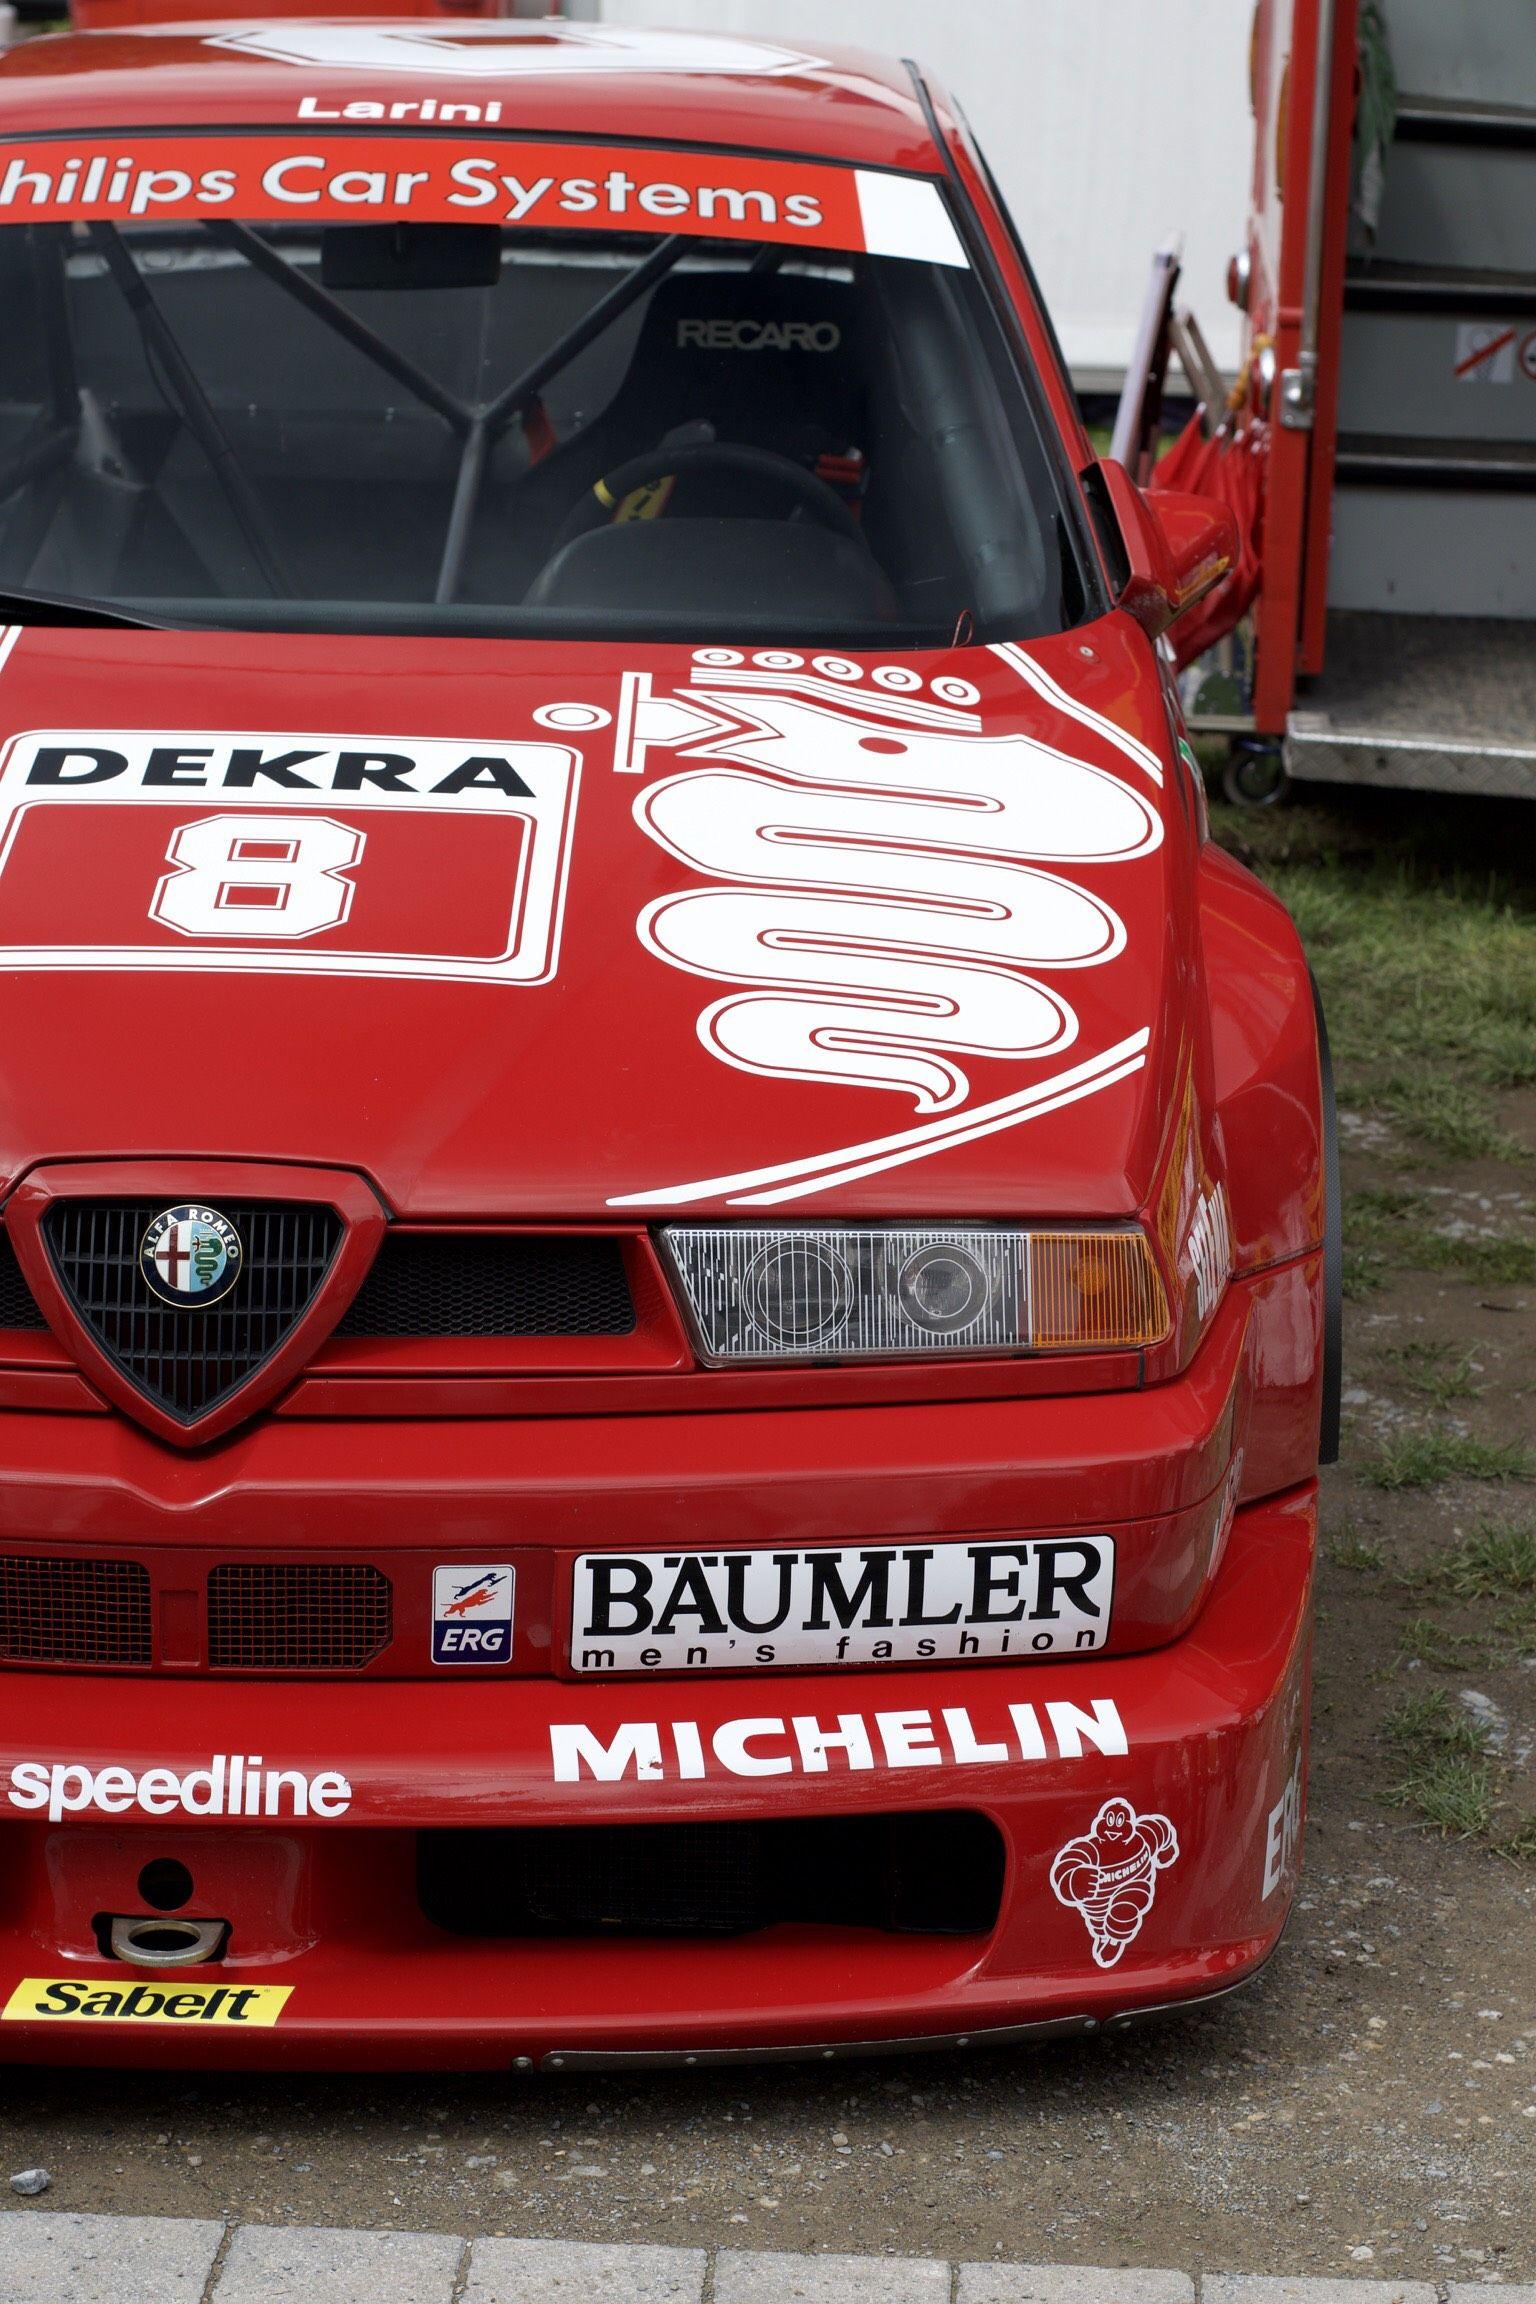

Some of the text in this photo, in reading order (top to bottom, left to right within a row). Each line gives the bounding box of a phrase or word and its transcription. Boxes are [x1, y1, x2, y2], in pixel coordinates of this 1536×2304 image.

[298, 97, 503, 123] Larini
[261, 155, 429, 205] Car
[446, 158, 822, 226] Systems
[678, 319, 840, 353] RECARO
[26, 747, 537, 798] DEKRA
[147, 814, 368, 940] 8
[143, 1208, 239, 1259] ALFA ROMEO
[583, 1541, 1101, 1636] BÄUMLER
[440, 1628, 504, 1652] ERG
[836, 1626, 1098, 1660] fashion
[549, 1699, 1129, 1782] MICHELIN
[7, 1754, 352, 1823] speedline
[1100, 1850, 1149, 1884] MICHELIN
[35, 1982, 260, 2020] Sabelt
